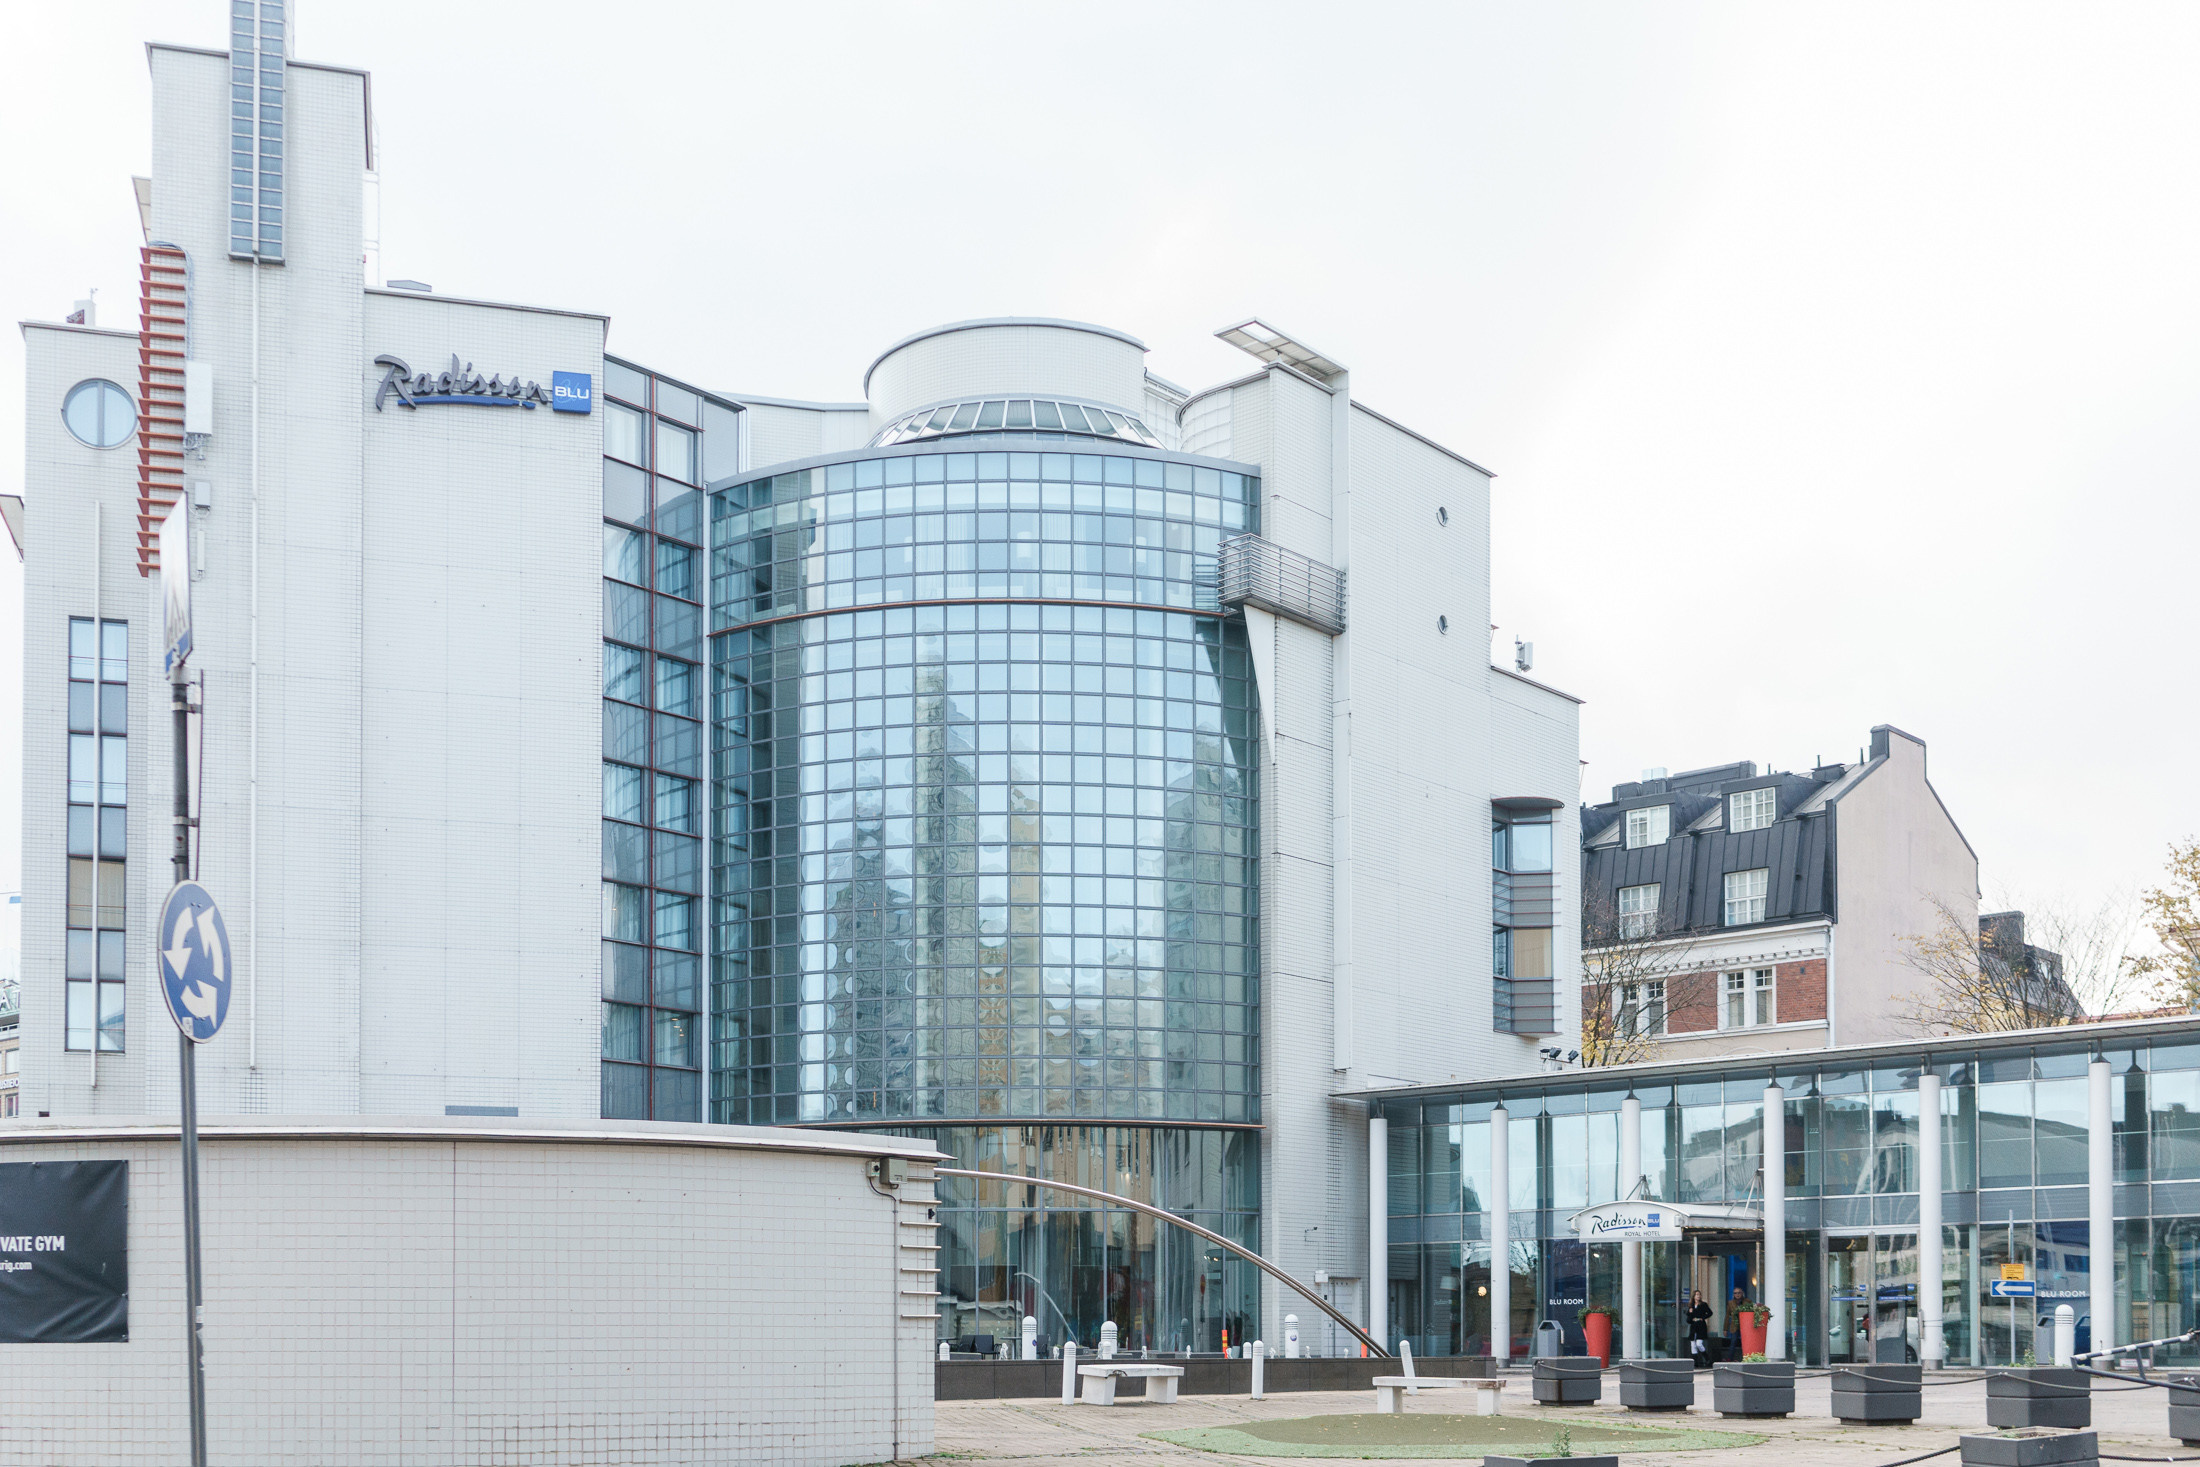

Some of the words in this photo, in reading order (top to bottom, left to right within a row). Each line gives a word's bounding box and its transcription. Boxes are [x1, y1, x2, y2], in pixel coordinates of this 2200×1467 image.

[374, 353, 548, 412] Radisson
[1591, 1212, 1646, 1235] Radisson
[35, 1235, 65, 1251] GYM
[2041, 1290, 2057, 1298] BLU
[2059, 1290, 2086, 1298] ROOM
